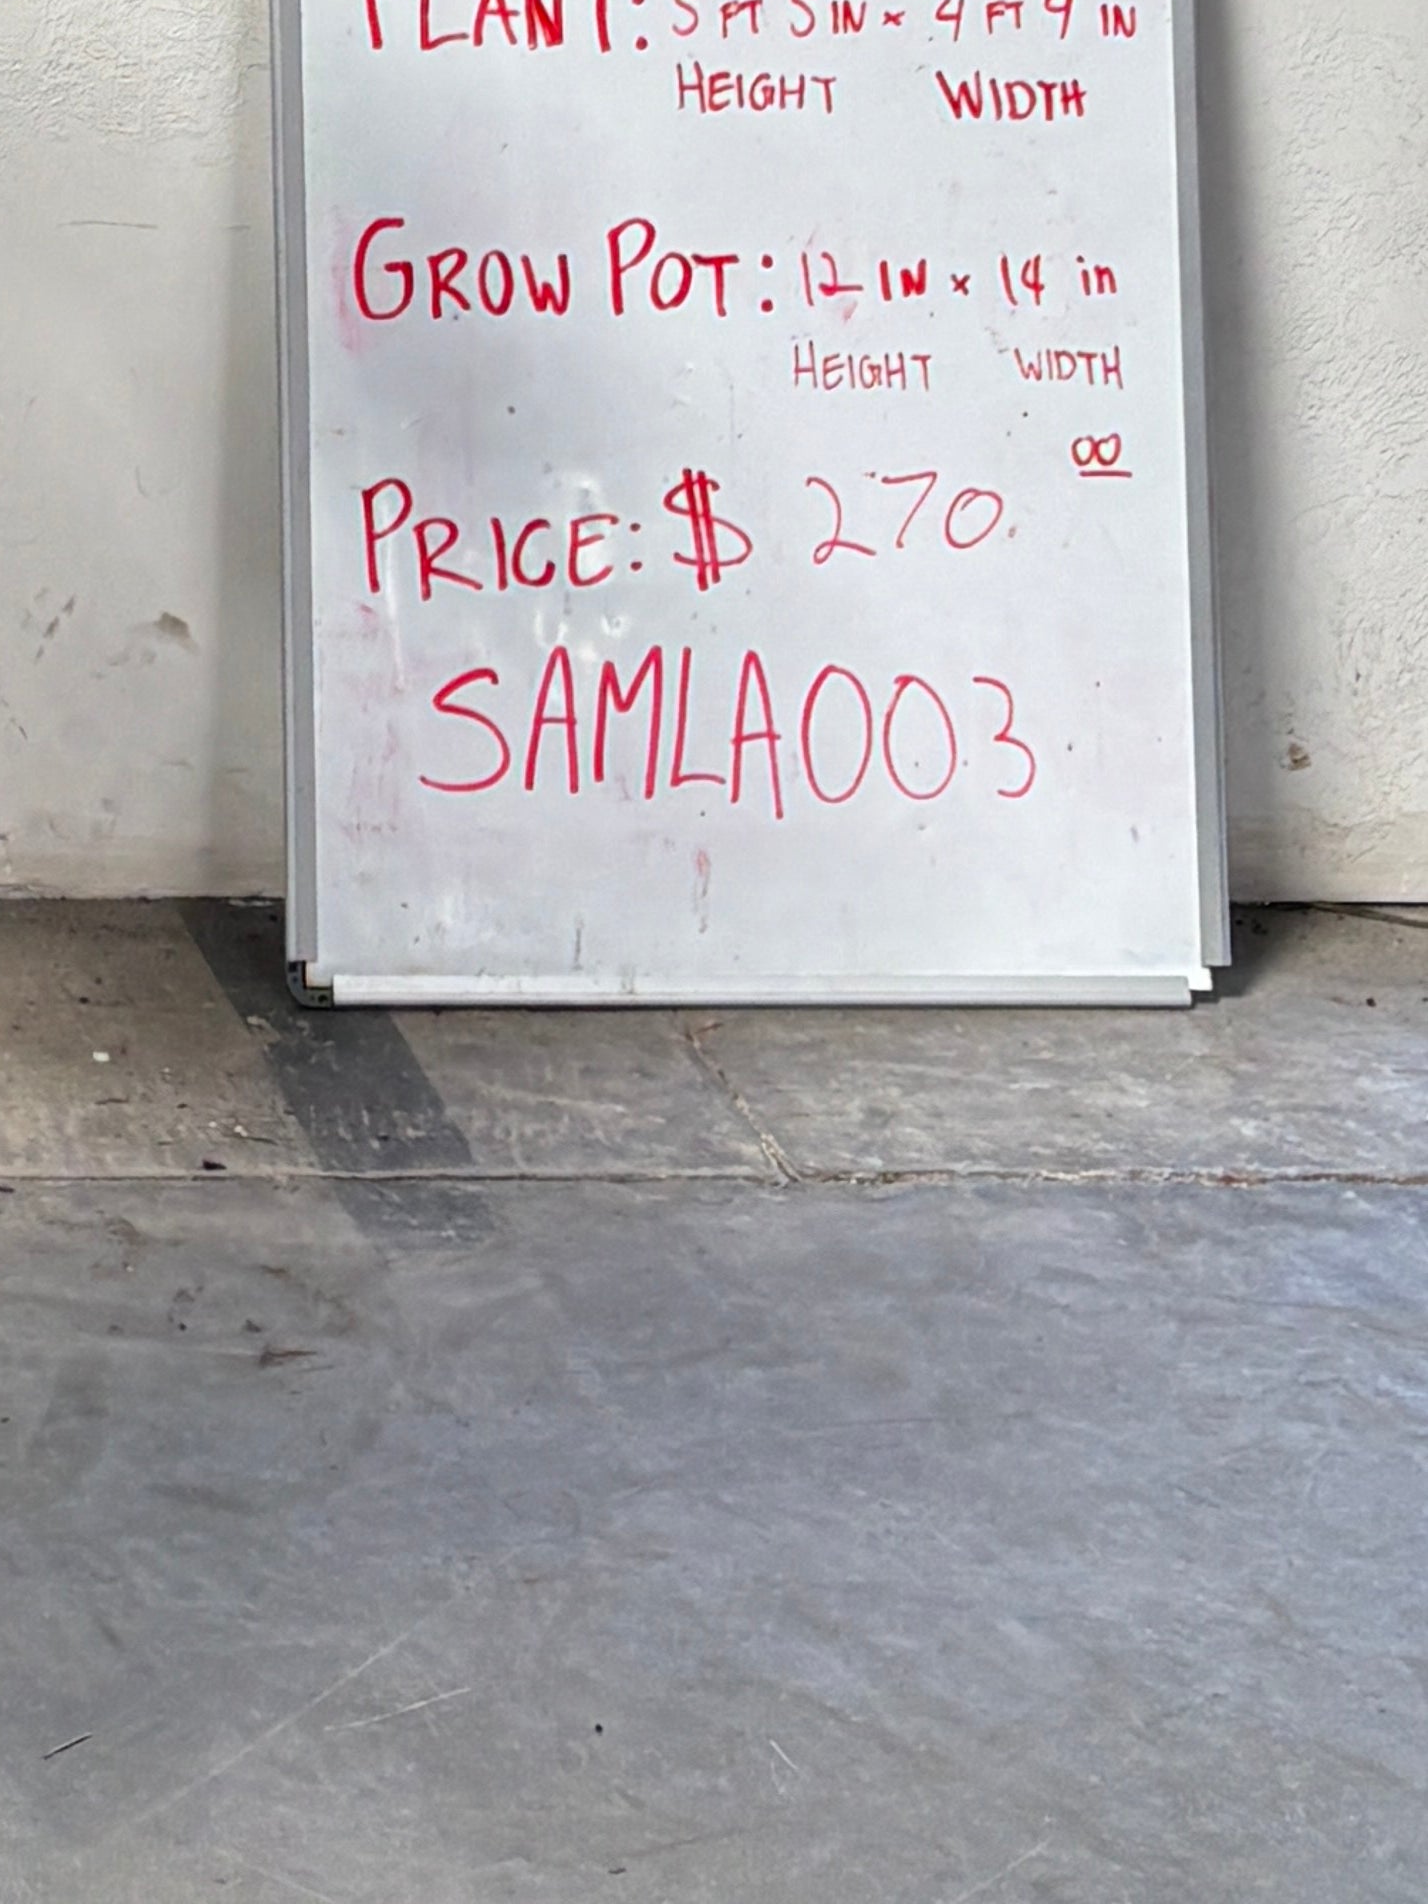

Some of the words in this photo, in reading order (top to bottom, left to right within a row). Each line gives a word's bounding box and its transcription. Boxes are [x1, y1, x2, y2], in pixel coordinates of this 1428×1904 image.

[830, 0, 866, 34] IN
[985, 0, 1025, 33] FT
[1099, 5, 1137, 39] IN
[677, 64, 833, 113] HEIGHT
[935, 73, 1086, 122] WIDTH
[351, 217, 571, 321] GROW
[605, 217, 774, 318] POT:
[800, 252, 861, 304] 12
[878, 260, 928, 302] IN
[999, 255, 1045, 305] 14
[1076, 255, 1118, 297] in
[792, 340, 932, 392] HEIGHT
[1012, 345, 1124, 391] WIDTH
[360, 478, 641, 601] PRICE:
[661, 468, 753, 593] $
[421, 645, 1035, 820] SAMLA003
